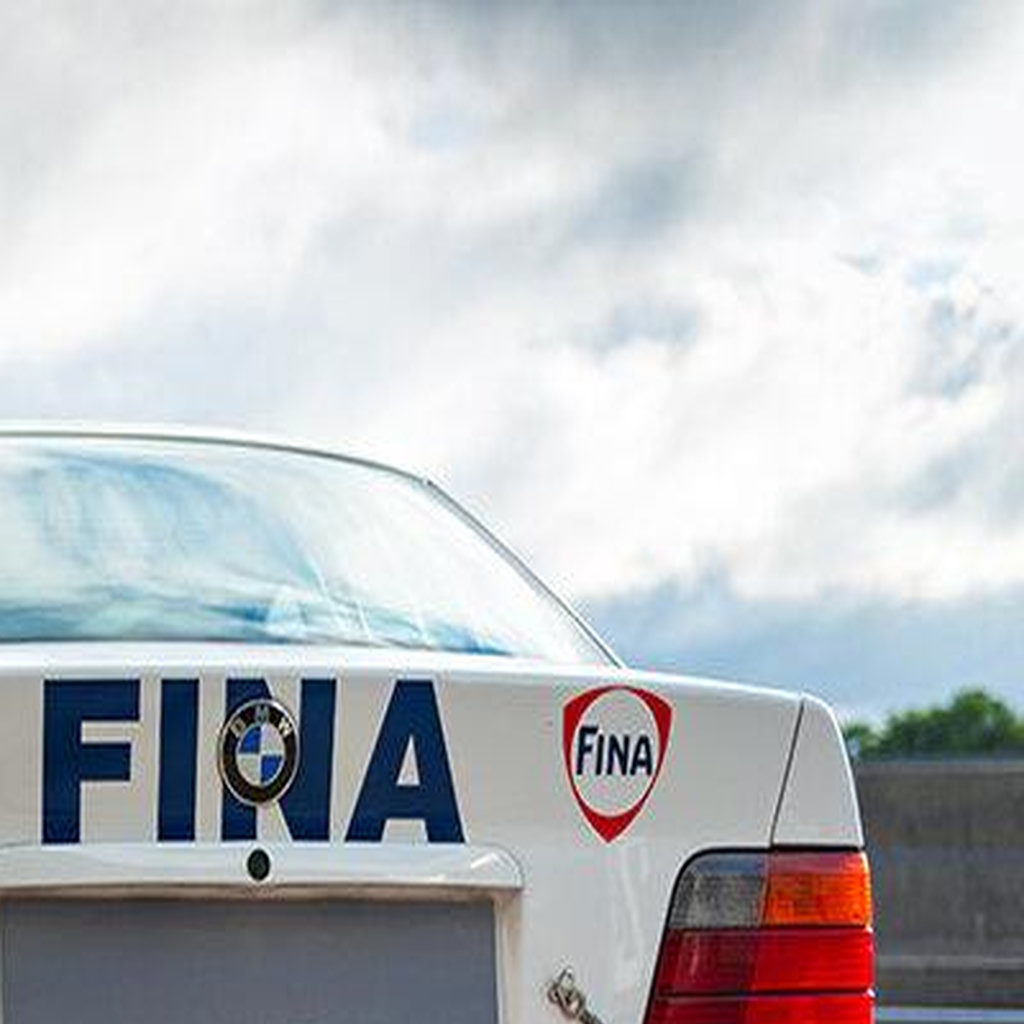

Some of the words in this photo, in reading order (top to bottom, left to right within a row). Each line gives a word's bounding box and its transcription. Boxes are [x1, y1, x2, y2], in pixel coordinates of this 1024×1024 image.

[230, 704, 293, 738] BMW
[42, 679, 465, 845] FINA
[576, 726, 653, 776] FINA
